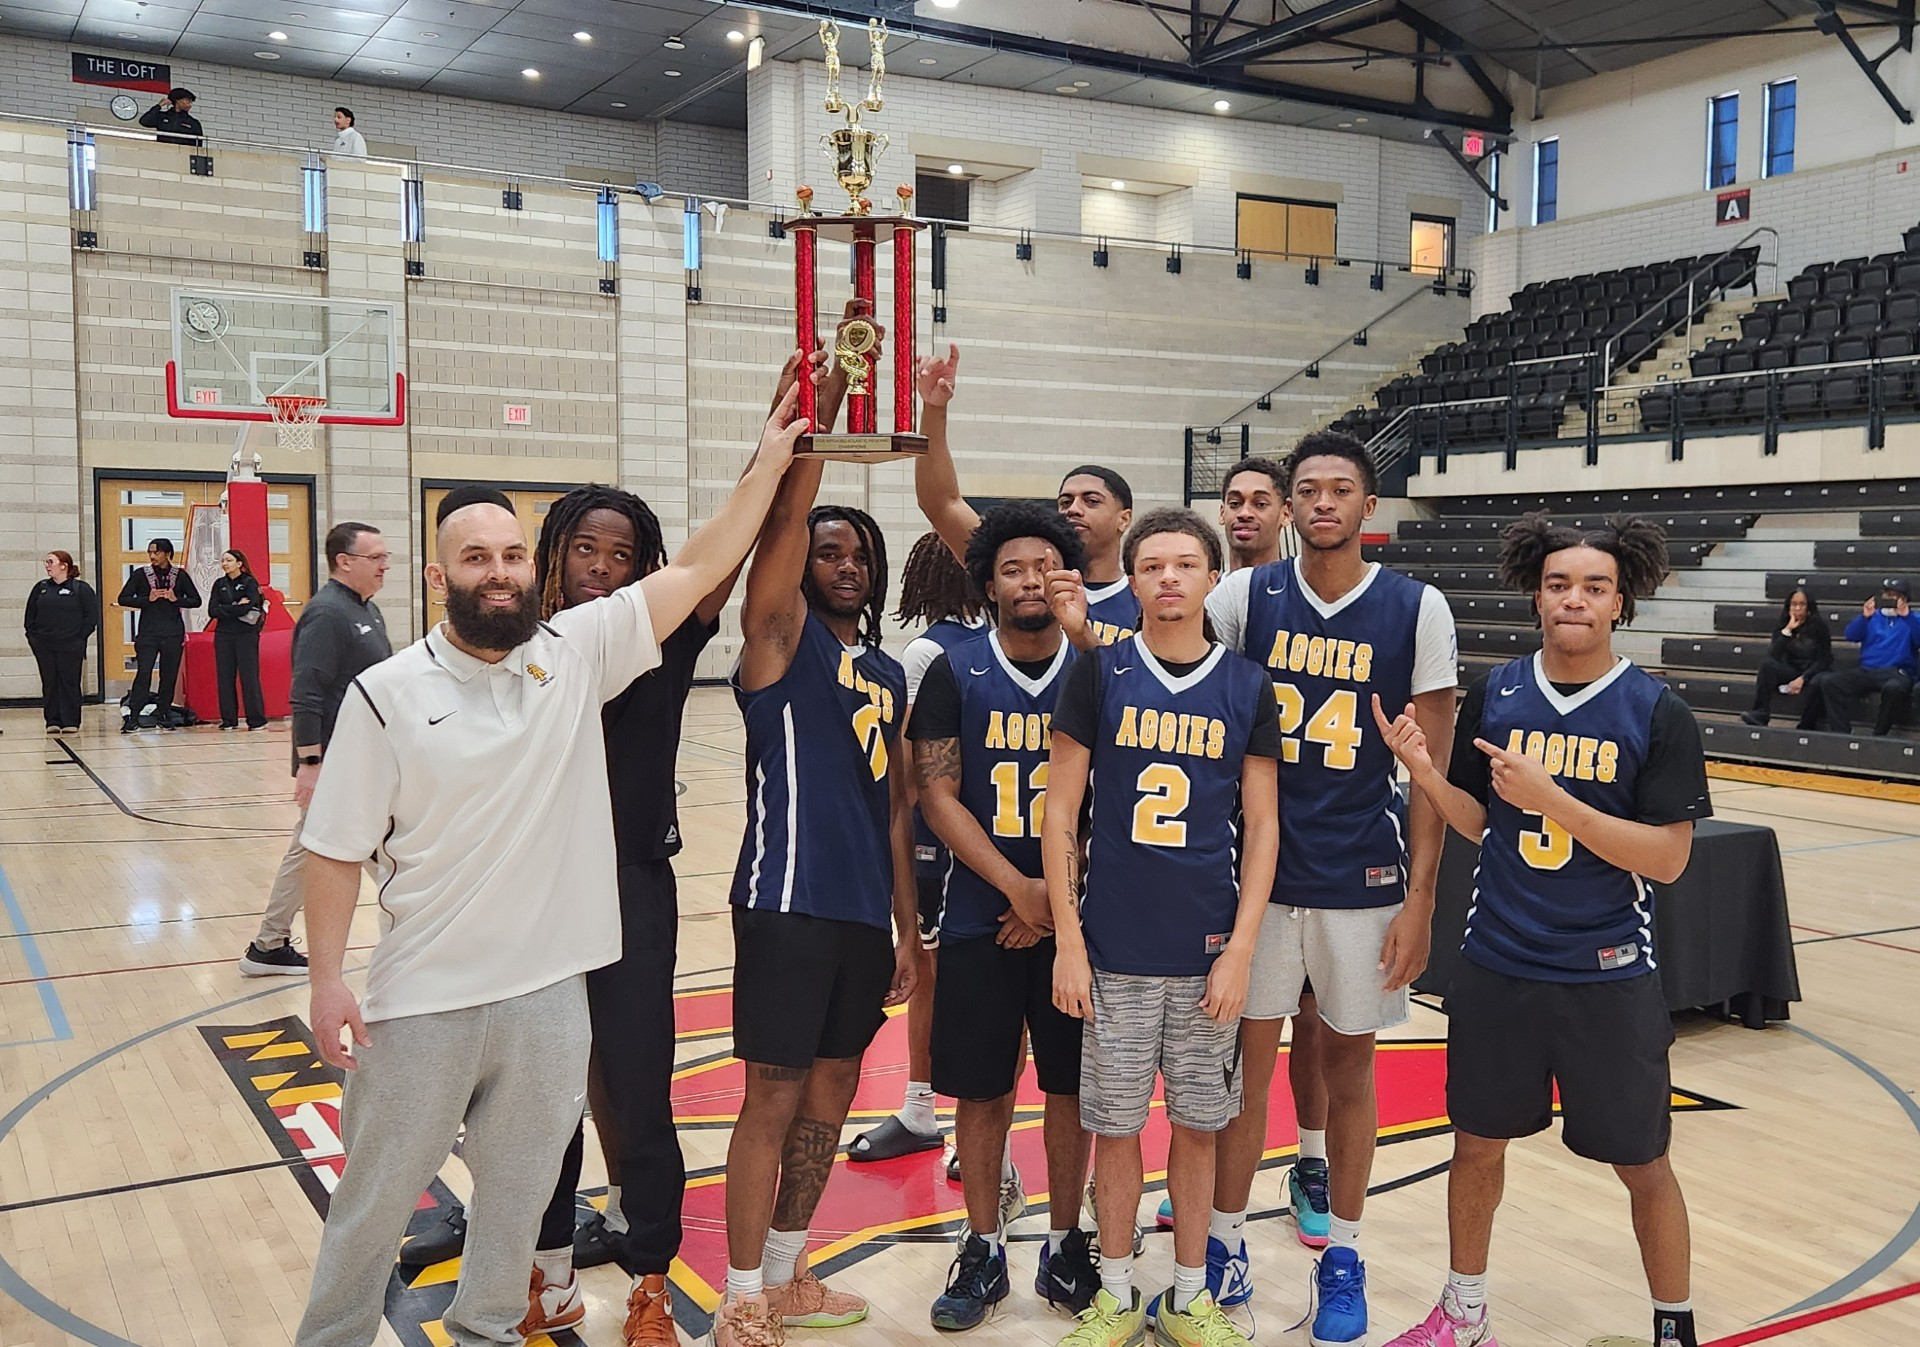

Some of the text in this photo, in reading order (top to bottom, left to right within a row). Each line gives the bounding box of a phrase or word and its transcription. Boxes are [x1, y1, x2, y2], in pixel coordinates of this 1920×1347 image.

[87, 57, 156, 80] THE LOFT
[1725, 199, 1741, 220] A
[508, 407, 527, 421] EXIT
[1267, 630, 1373, 682] AGGIES
[985, 711, 1052, 751] AGGI
[1115, 706, 1226, 759] AGGIES
[1272, 682, 1363, 770] 24
[1506, 729, 1619, 783] AGGIES
[1132, 762, 1191, 847] 2
